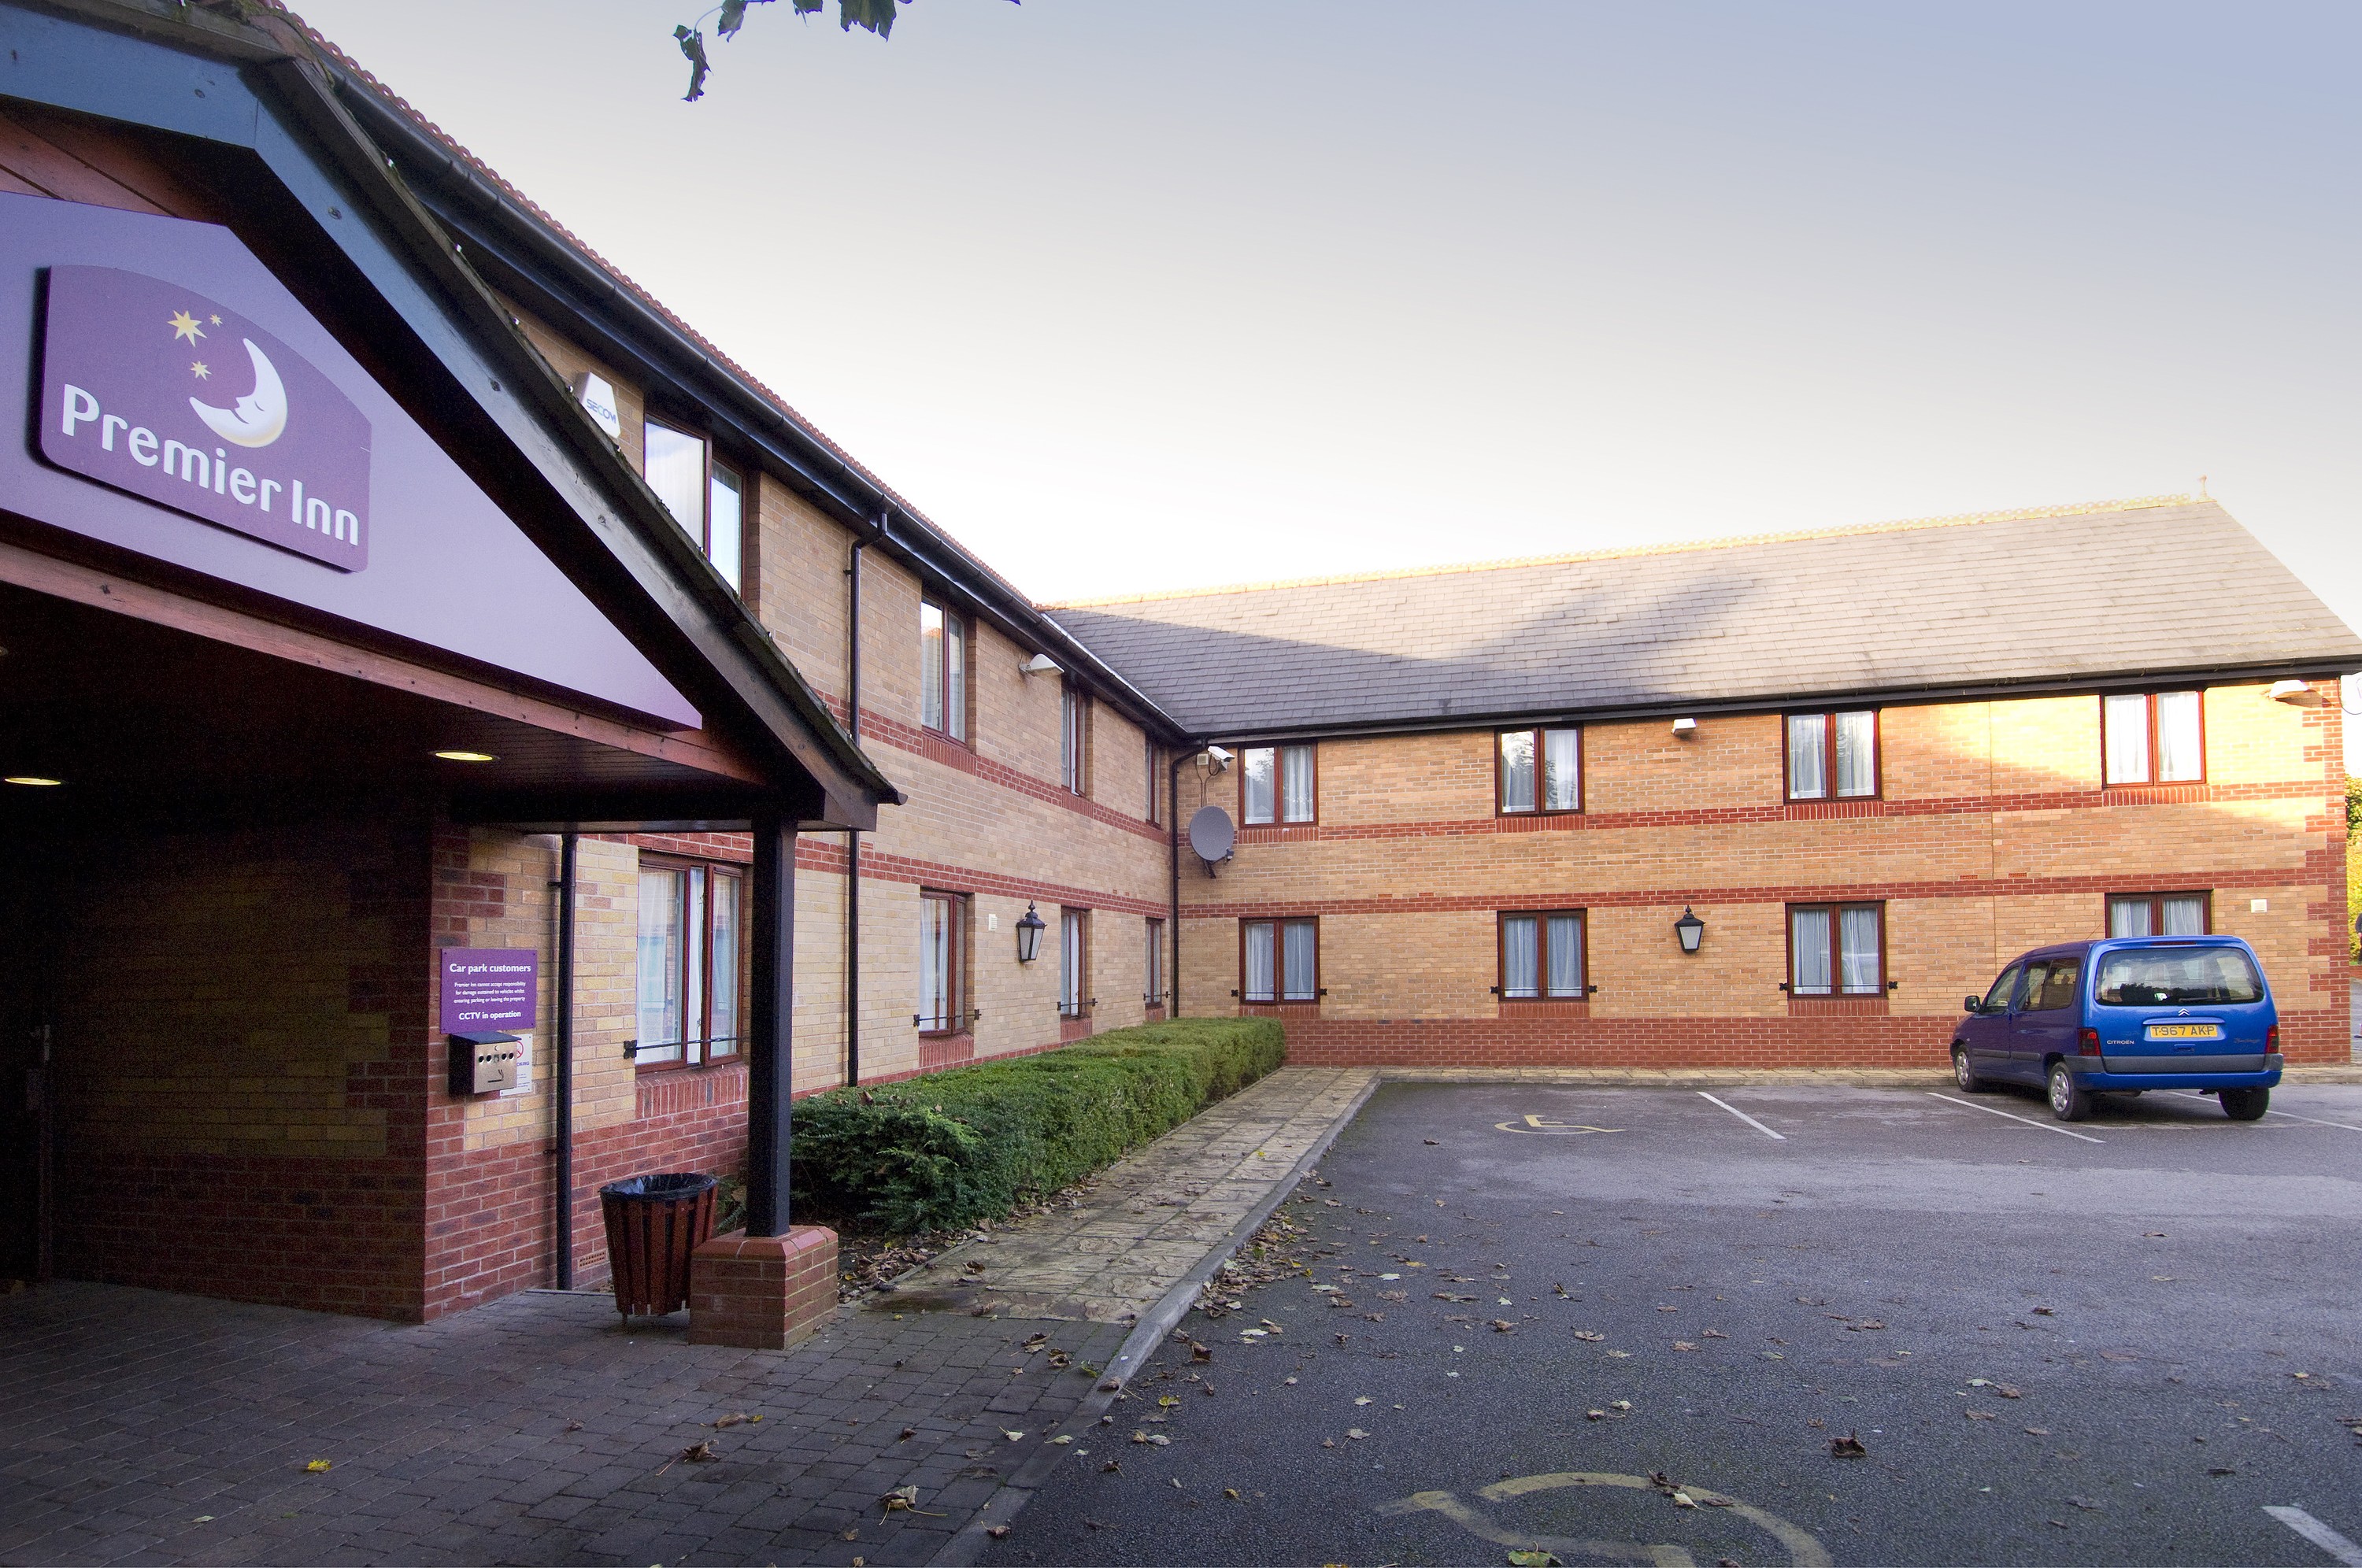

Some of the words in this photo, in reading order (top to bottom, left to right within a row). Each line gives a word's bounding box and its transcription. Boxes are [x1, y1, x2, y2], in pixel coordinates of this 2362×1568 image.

[587, 398, 616, 424] SECOM
[61, 383, 282, 512] Premier
[292, 479, 359, 545] Inn
[450, 963, 466, 972] Car
[468, 963, 487, 974] park
[459, 1011, 481, 1020] CCTV
[490, 1010, 521, 1020] operation
[2152, 1026, 2186, 1036] T967
[2190, 1026, 2215, 1036] AKP
